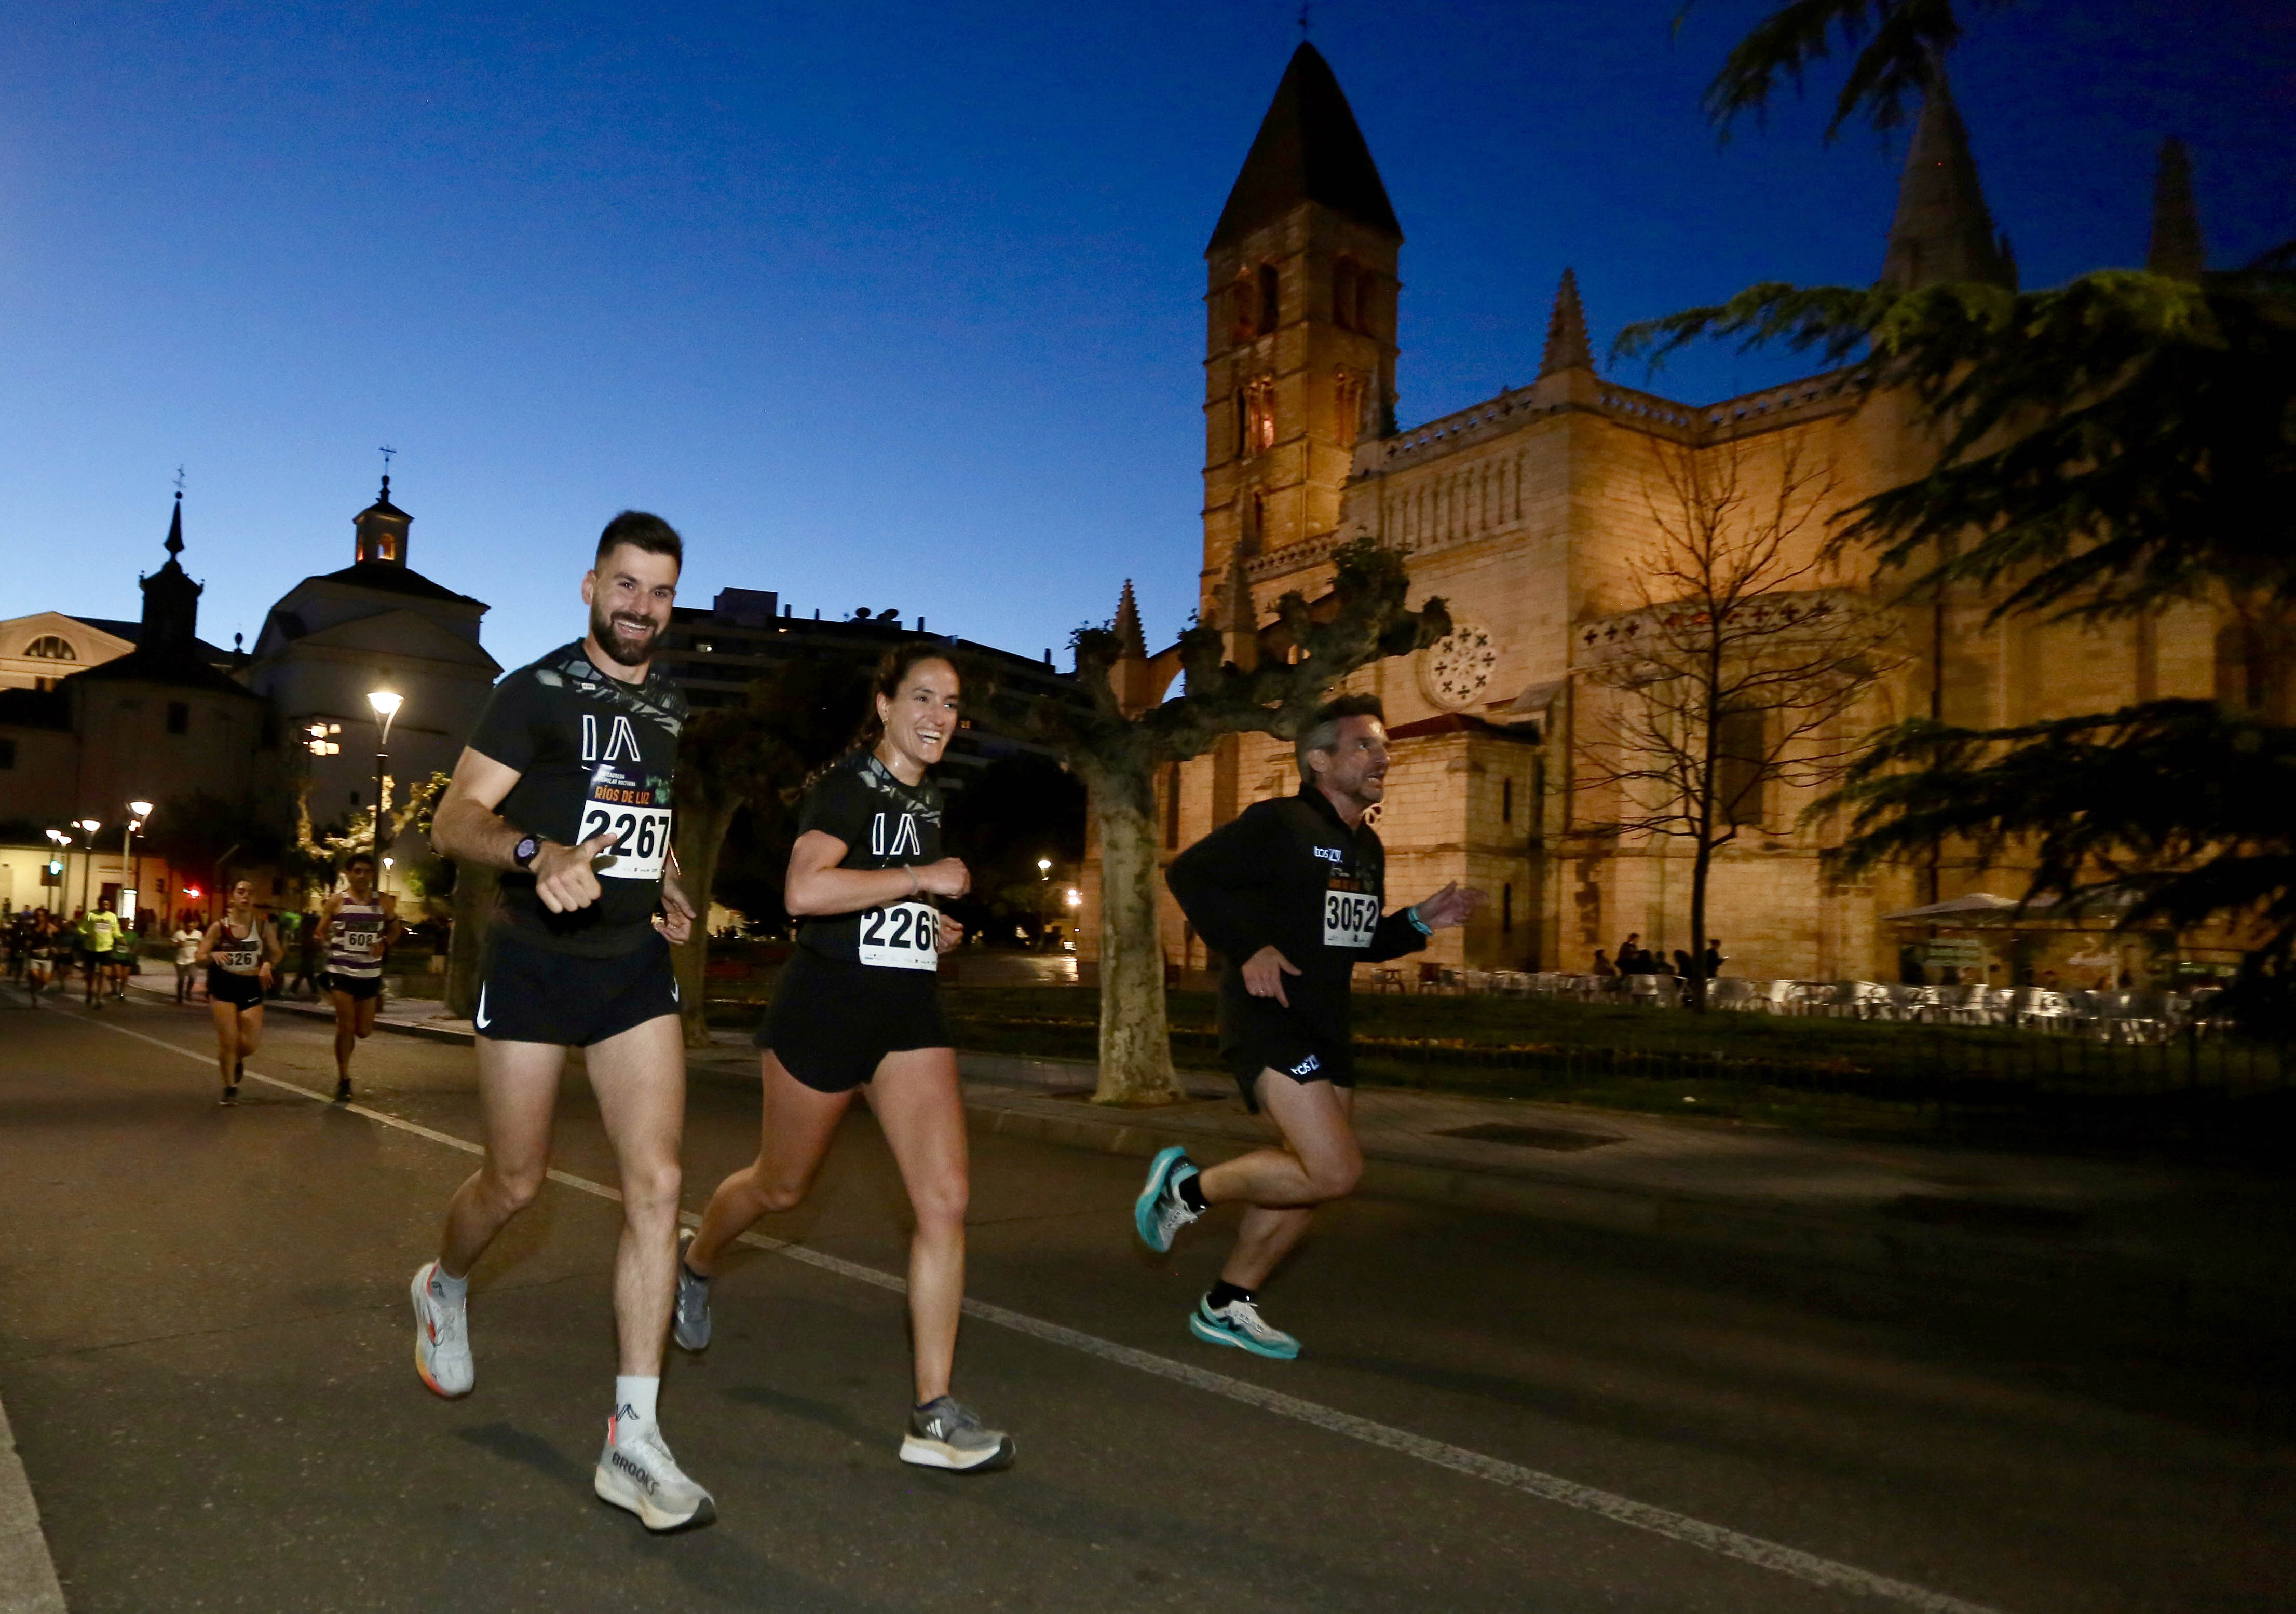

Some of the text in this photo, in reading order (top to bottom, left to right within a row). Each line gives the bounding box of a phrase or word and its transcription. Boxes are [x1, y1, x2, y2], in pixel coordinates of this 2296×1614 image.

[621, 790, 634, 804] DE
[635, 791, 651, 805] LUZ
[581, 810, 670, 859] 2267
[1327, 896, 1377, 933] 3052
[349, 933, 373, 946] 608
